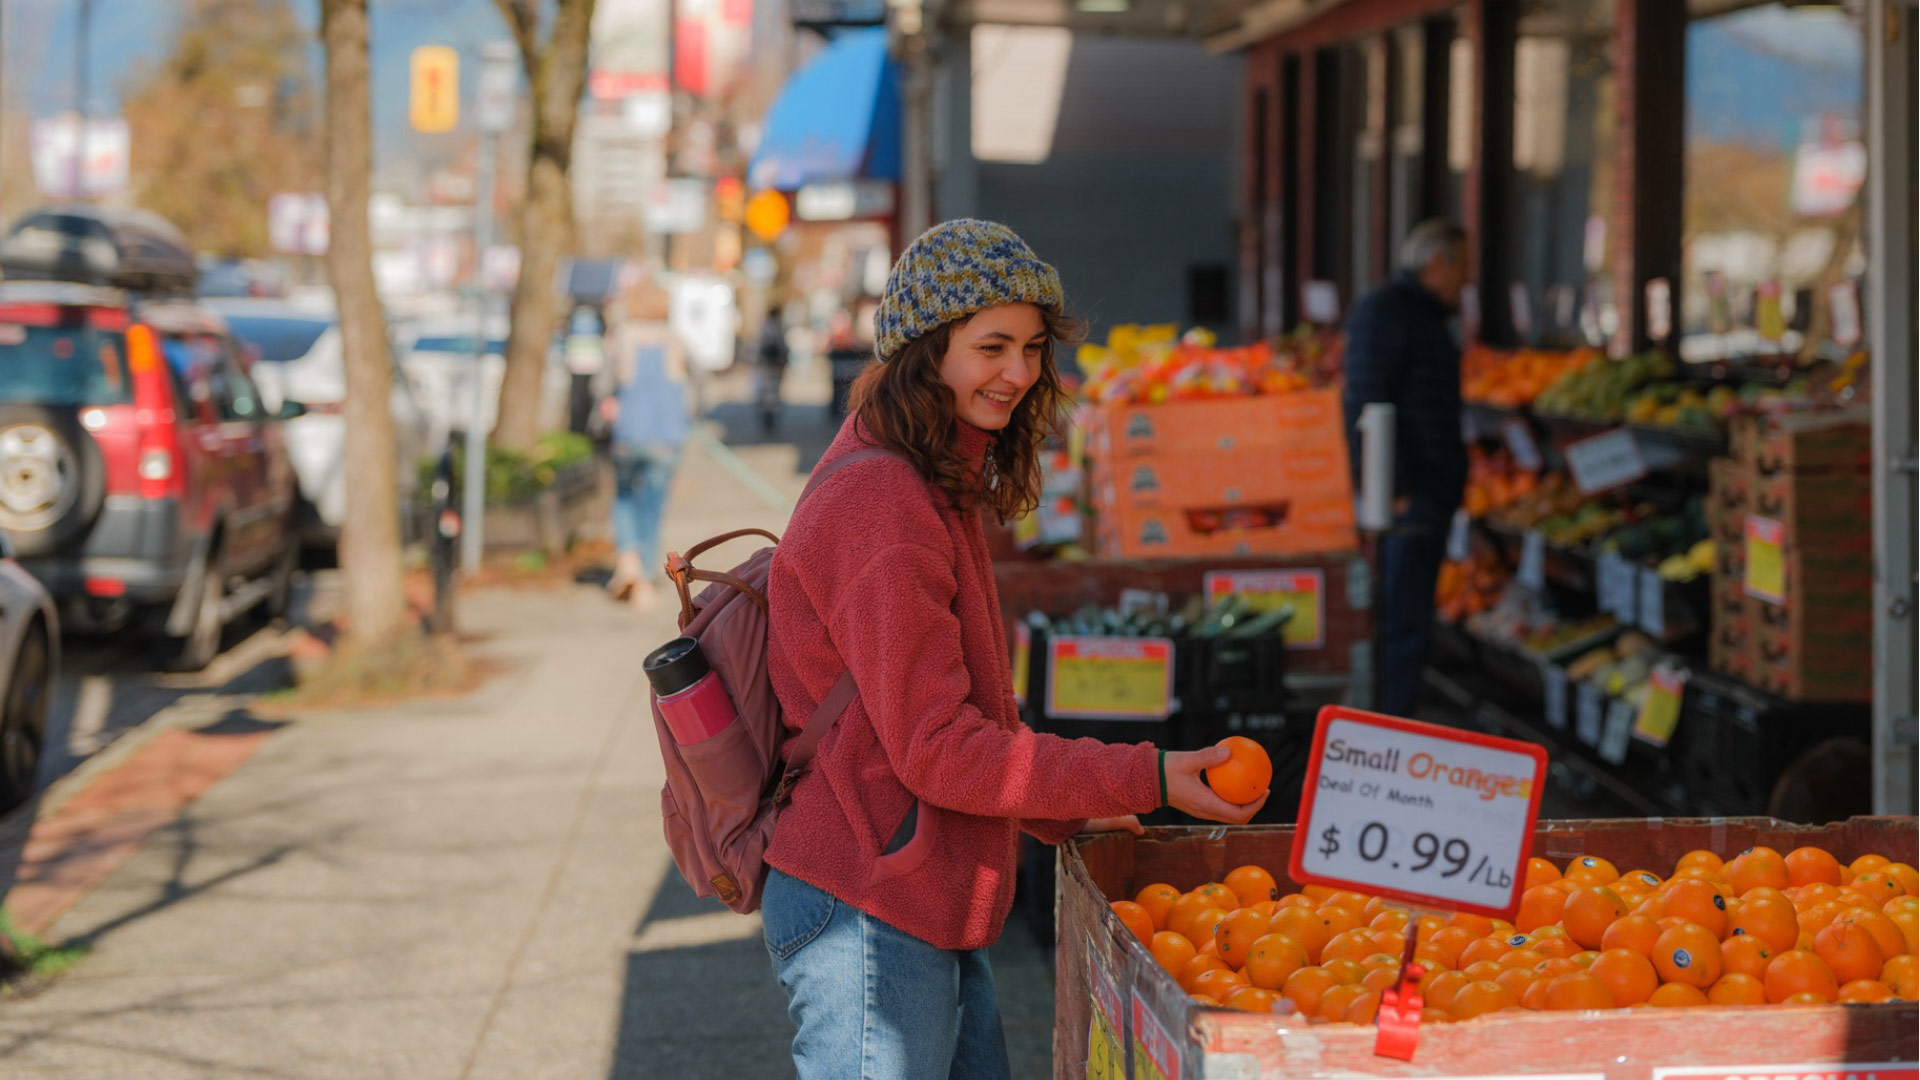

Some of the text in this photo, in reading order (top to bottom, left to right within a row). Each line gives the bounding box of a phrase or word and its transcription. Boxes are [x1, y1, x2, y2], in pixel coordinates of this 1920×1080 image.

[1325, 738, 1533, 801] Small Oranges
[1318, 774, 1434, 809] Deal Of Month
[1318, 824, 1341, 860] $
